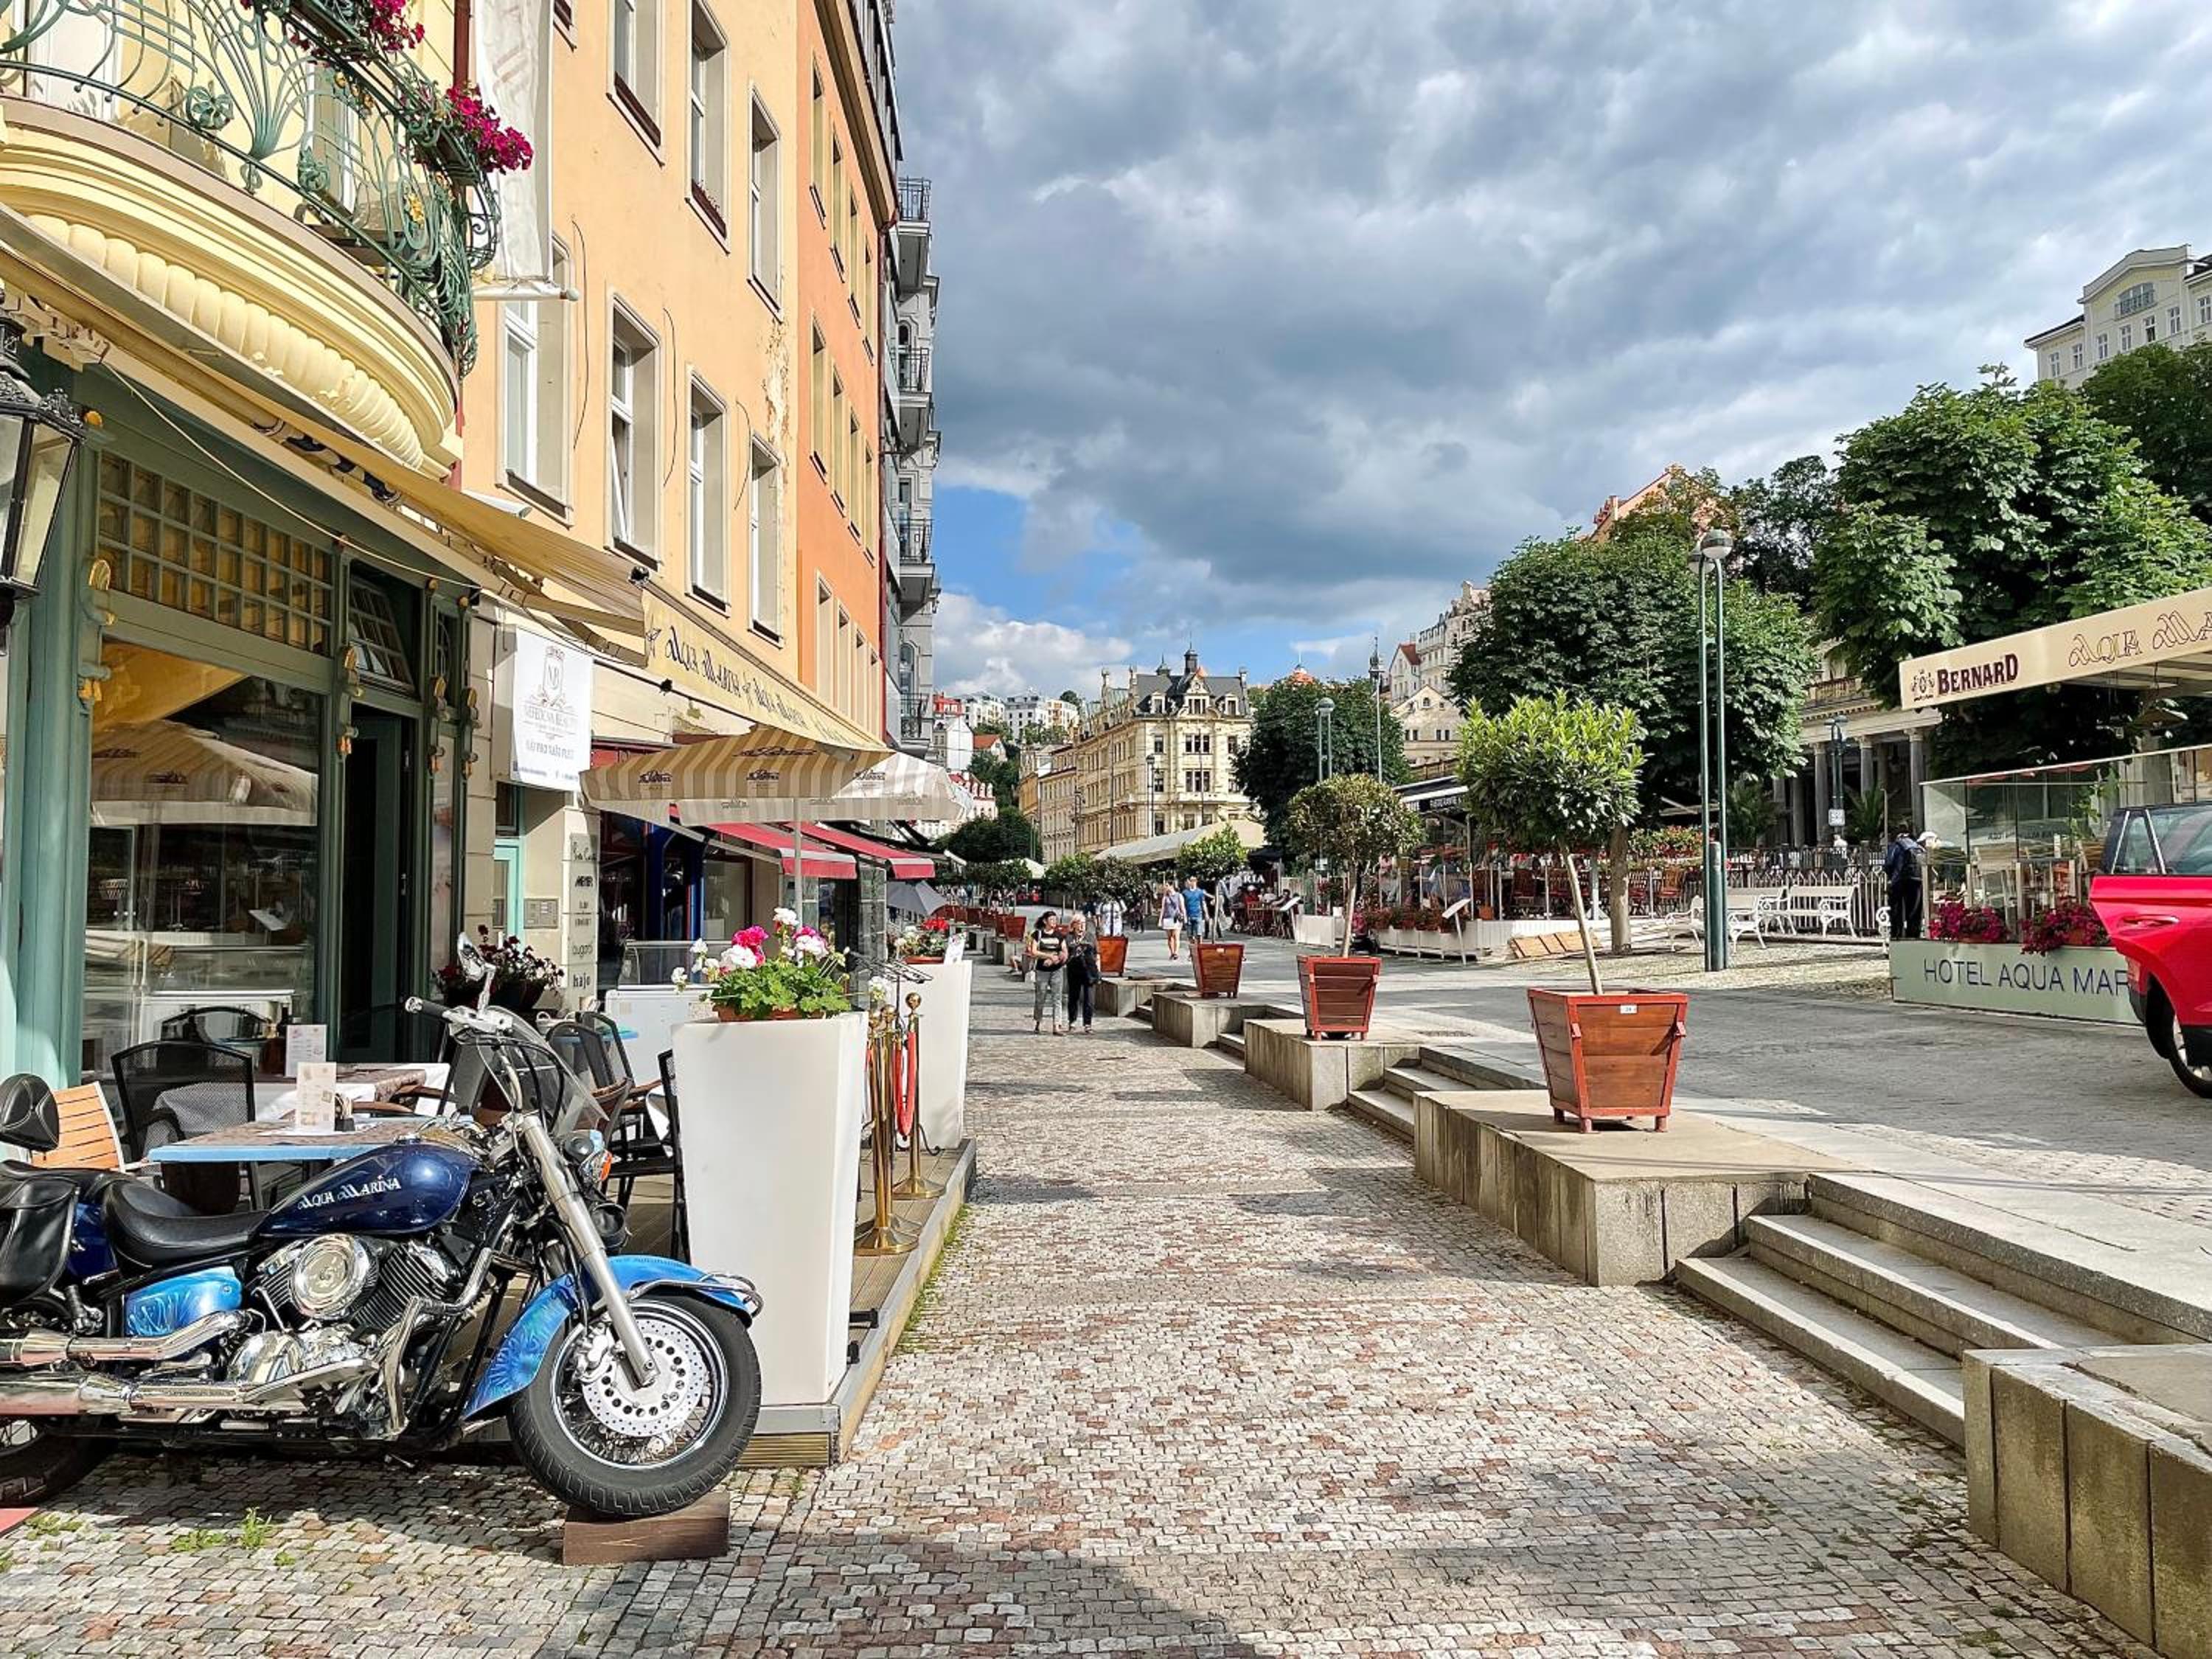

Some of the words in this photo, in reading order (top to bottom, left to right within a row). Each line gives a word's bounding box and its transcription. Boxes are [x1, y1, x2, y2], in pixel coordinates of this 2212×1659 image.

[2069, 634, 2143, 667] AQUA
[1937, 653, 2018, 695] BERNARD
[1924, 959, 1992, 987] HOTEL
[1998, 963, 2065, 992] AQUA
[297, 1193, 335, 1209] AQUA
[337, 1174, 402, 1200] MARINA
